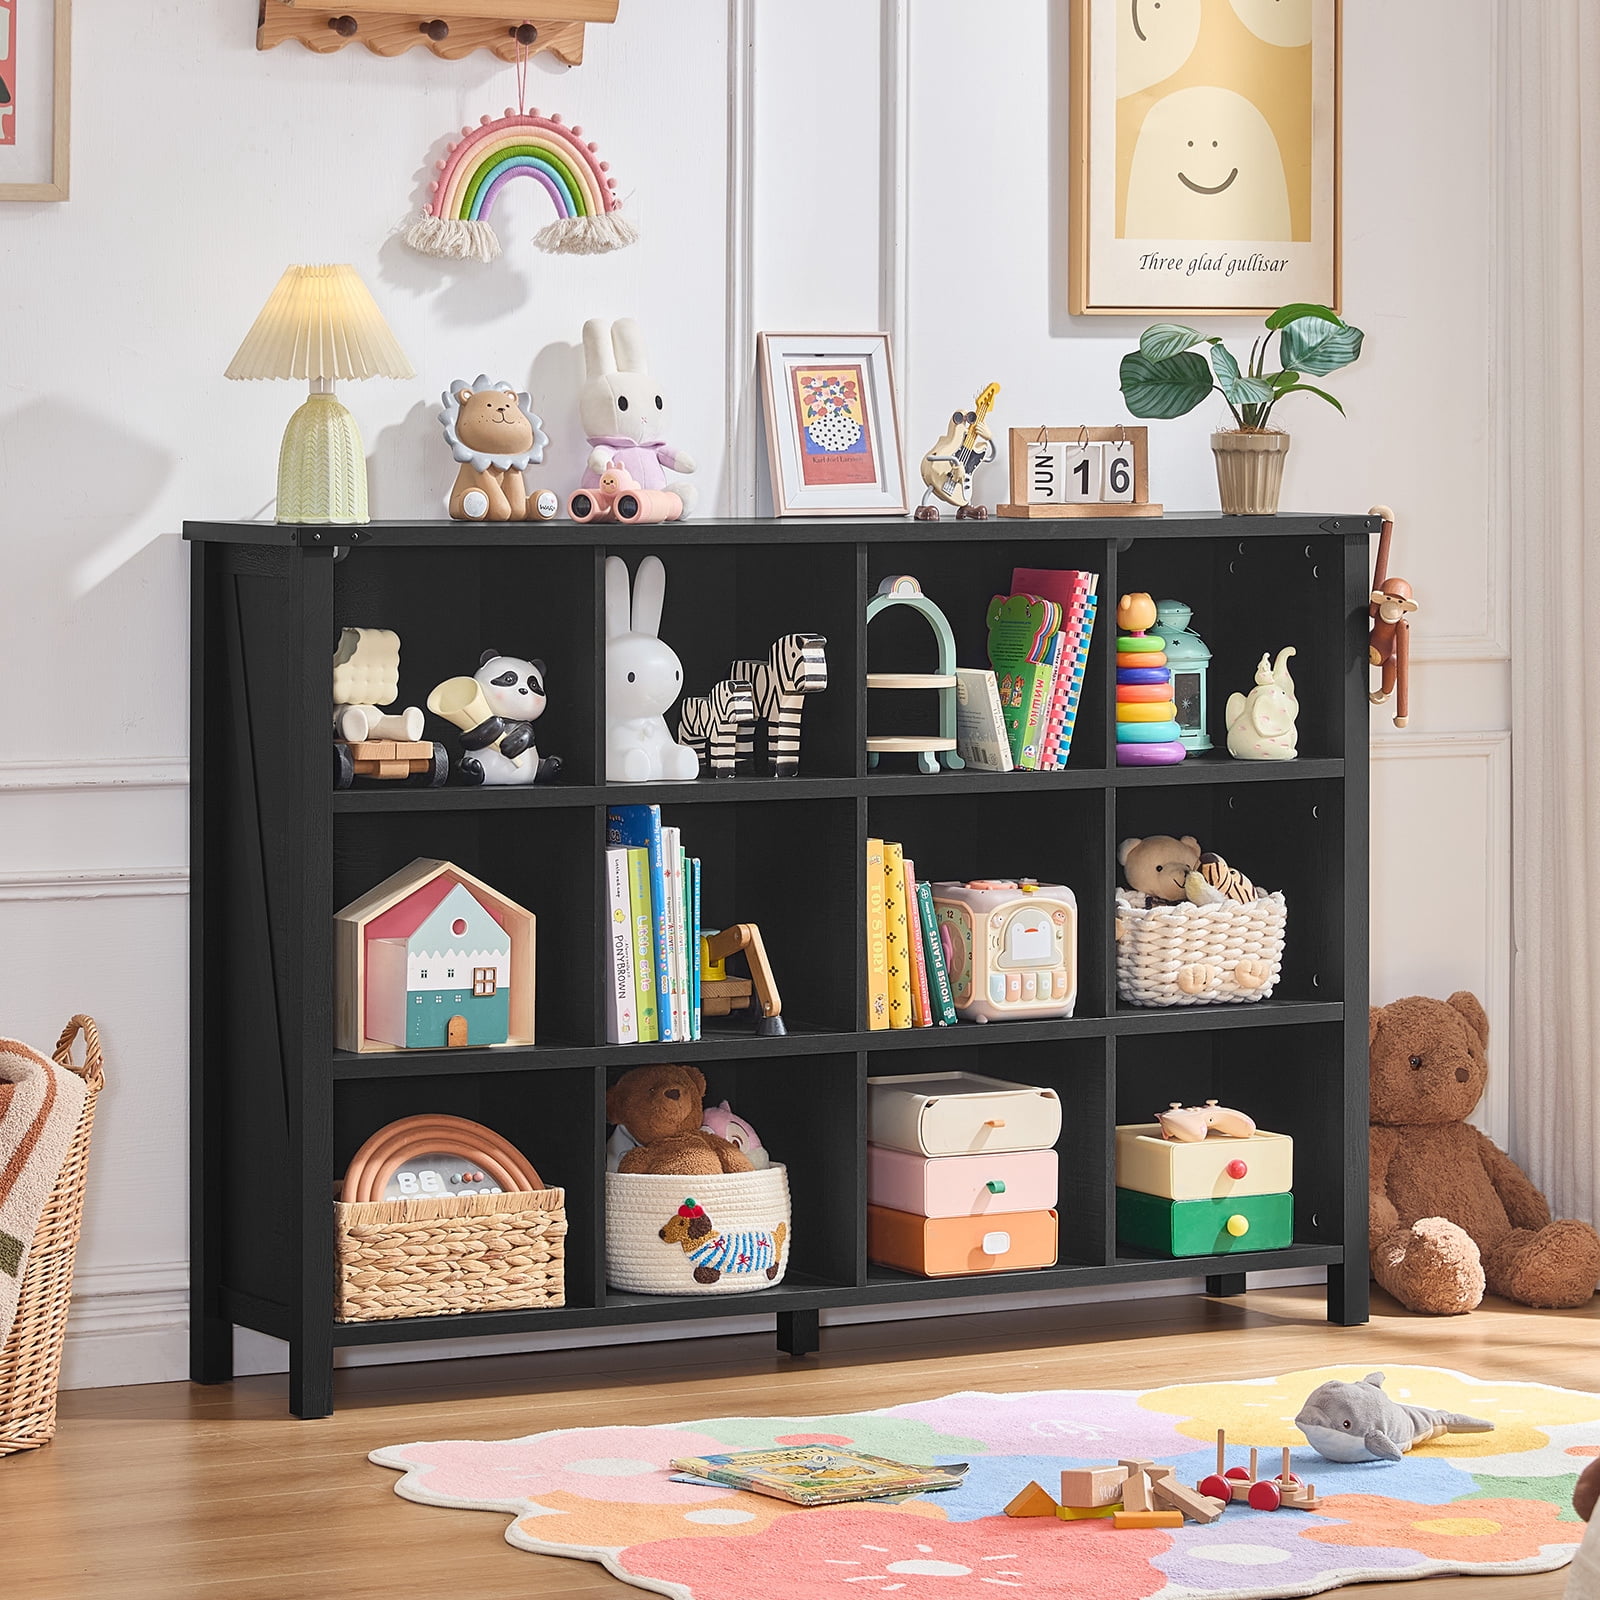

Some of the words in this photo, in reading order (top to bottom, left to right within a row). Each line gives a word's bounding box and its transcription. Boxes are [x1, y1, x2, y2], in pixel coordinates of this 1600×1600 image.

[1138, 251, 1184, 270] Three
[1186, 252, 1227, 277] glad
[1224, 253, 1289, 277] gullisar
[1035, 455, 1054, 497] JUN
[1029, 679, 1044, 727] МИШКА
[871, 882, 882, 915] TOY
[946, 910, 954, 919] 12
[637, 915, 648, 955] Little
[872, 918, 884, 976] STORY
[929, 930, 943, 968] PLANTS
[966, 932, 971, 941] 2
[614, 934, 626, 999] PONYBROWN
[968, 952, 973, 961] 3
[640, 960, 650, 992] girls
[937, 970, 950, 1003] HOUSE
[958, 983, 963, 992] 5
[965, 970, 970, 978] 4
[1010, 980, 1019, 991] B
[1026, 979, 1034, 990] C
[1042, 979, 1050, 990] D
[1057, 978, 1065, 988] E
[397, 1170, 439, 1195] BE
